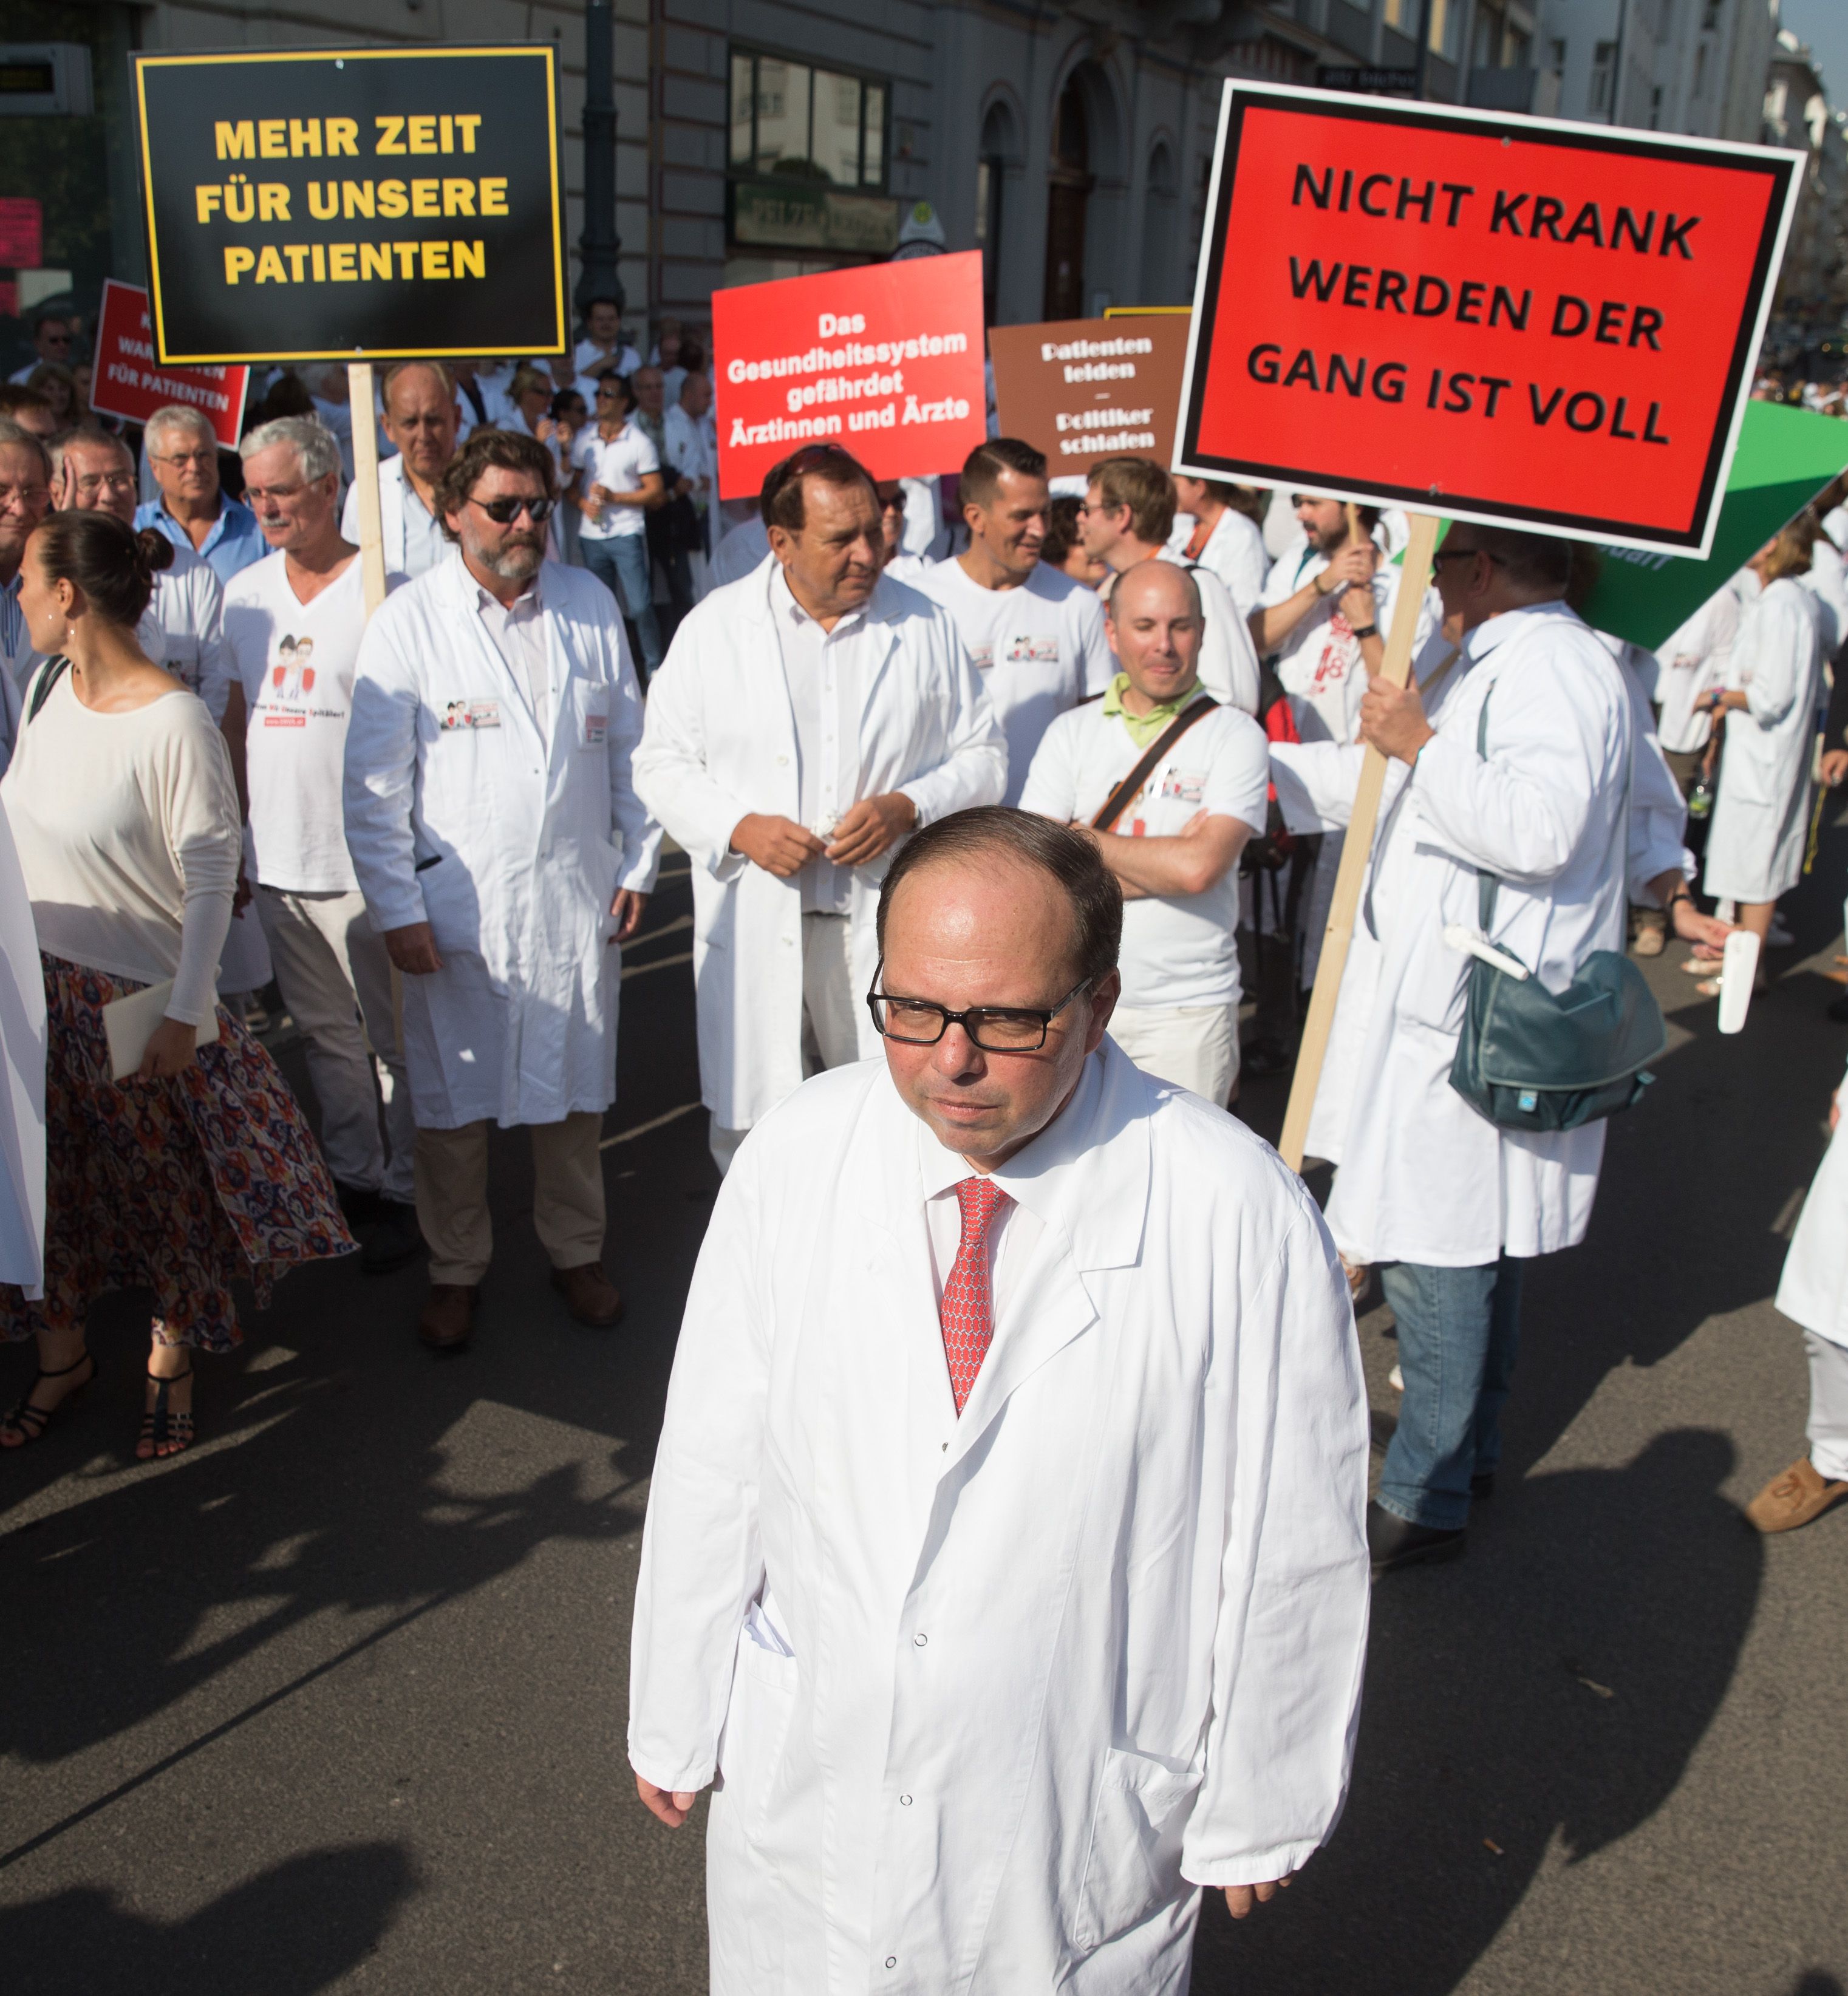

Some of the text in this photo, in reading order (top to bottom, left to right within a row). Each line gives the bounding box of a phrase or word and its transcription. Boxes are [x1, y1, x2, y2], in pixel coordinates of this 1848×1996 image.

[214, 114, 482, 160] MEHR ZEIT
[195, 174, 509, 223] FÜR UNSERE
[1292, 164, 1701, 260] NICHT KRANK
[223, 240, 486, 285] PATIENTEN
[818, 312, 867, 339] Das
[1289, 256, 1664, 351] WERDEN DER
[728, 331, 968, 384] Gesundheitssystem
[1040, 337, 1153, 362] Patienten
[1063, 361, 1136, 384] leiden
[107, 363, 139, 388] FÜR
[141, 372, 230, 413] PATIENTEN
[786, 369, 904, 413] gefährdet
[1247, 343, 1669, 445] GANG IST VOLL
[729, 393, 970, 448] Ärztinnen und Ärzte
[1055, 407, 1153, 432] Politiker
[1059, 430, 1156, 455] schlafen
